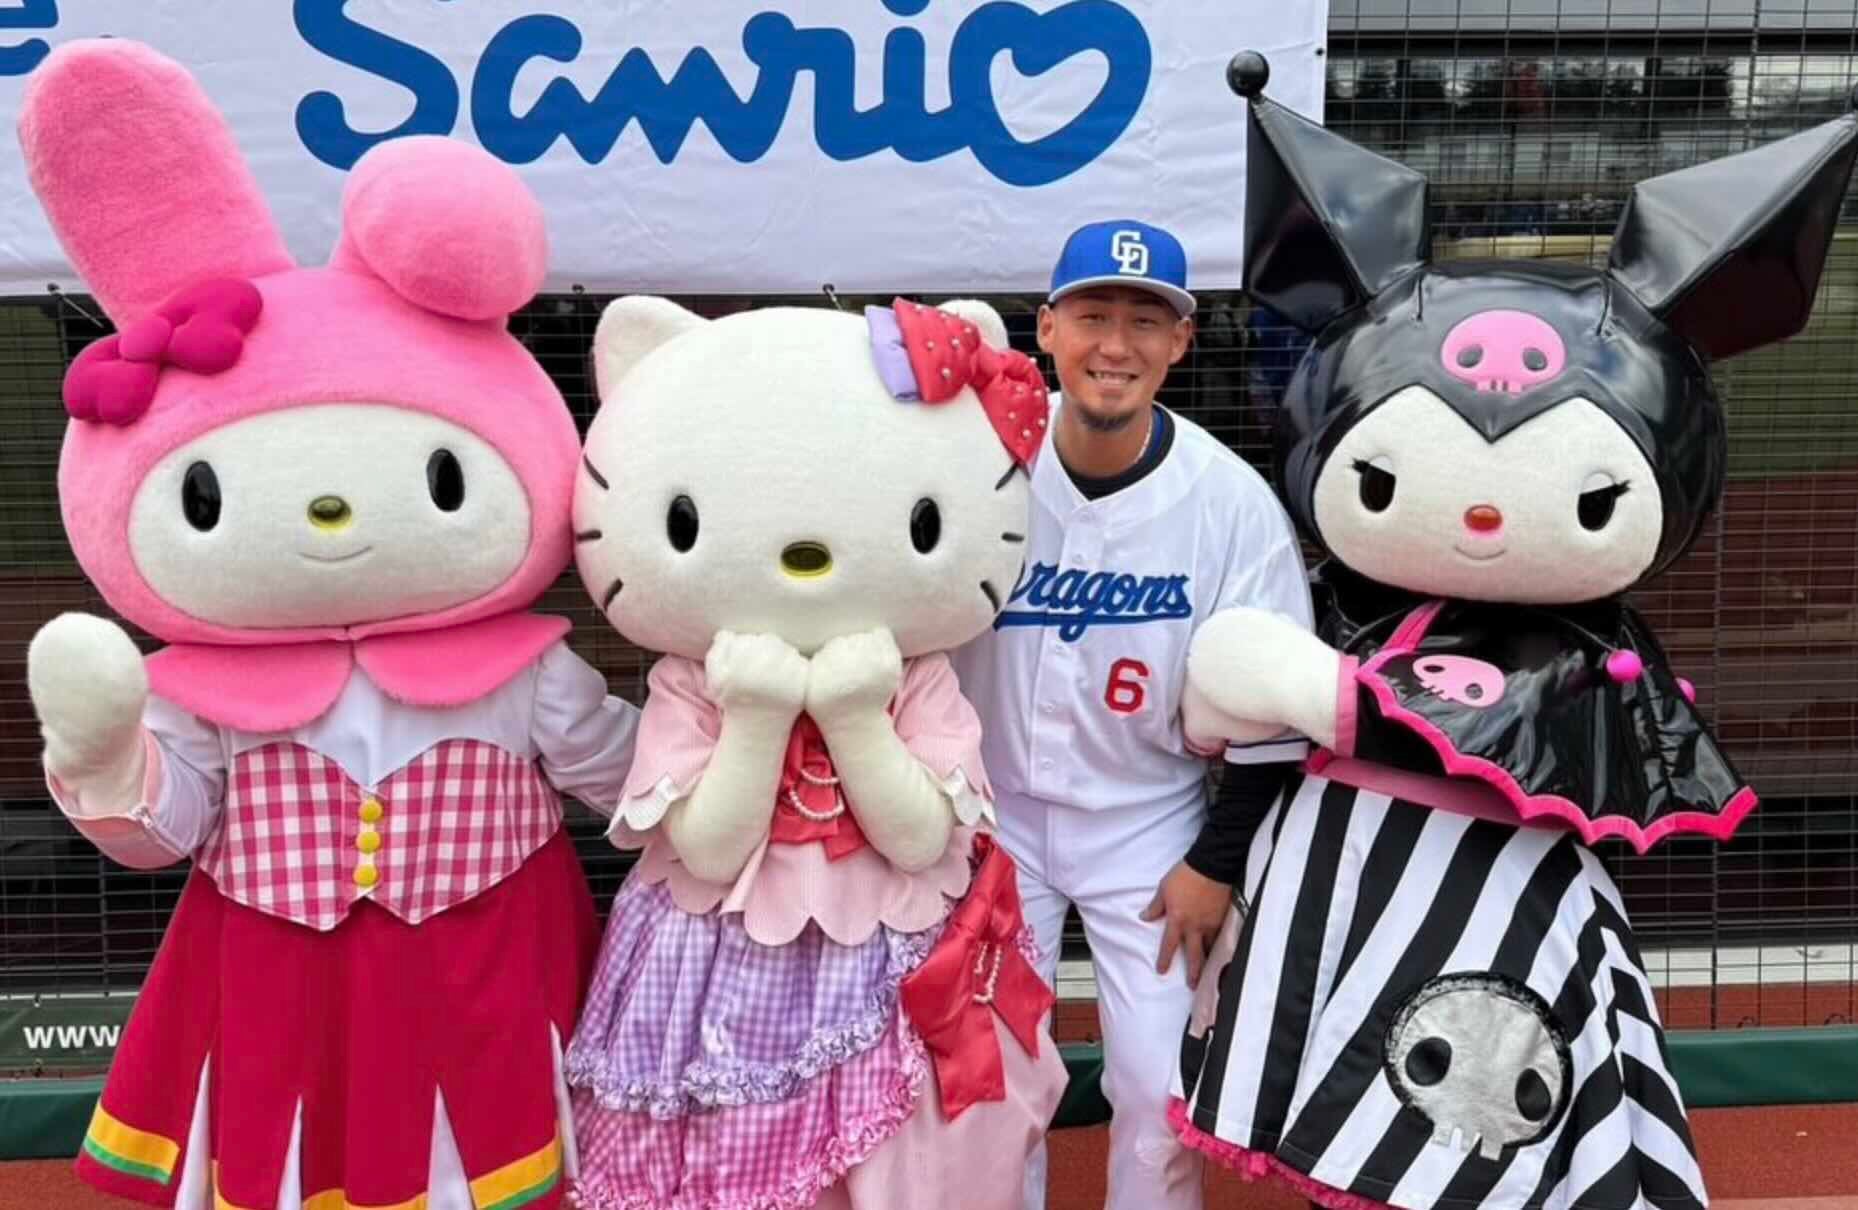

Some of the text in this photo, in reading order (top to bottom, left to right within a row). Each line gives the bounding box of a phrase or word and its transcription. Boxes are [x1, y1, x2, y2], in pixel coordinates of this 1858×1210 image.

[294, 0, 1152, 187] Sanrio
[1110, 229, 1150, 276] CD
[999, 560, 1192, 642] ragons
[1104, 657, 1149, 713] 6
[23, 1025, 120, 1050] www
